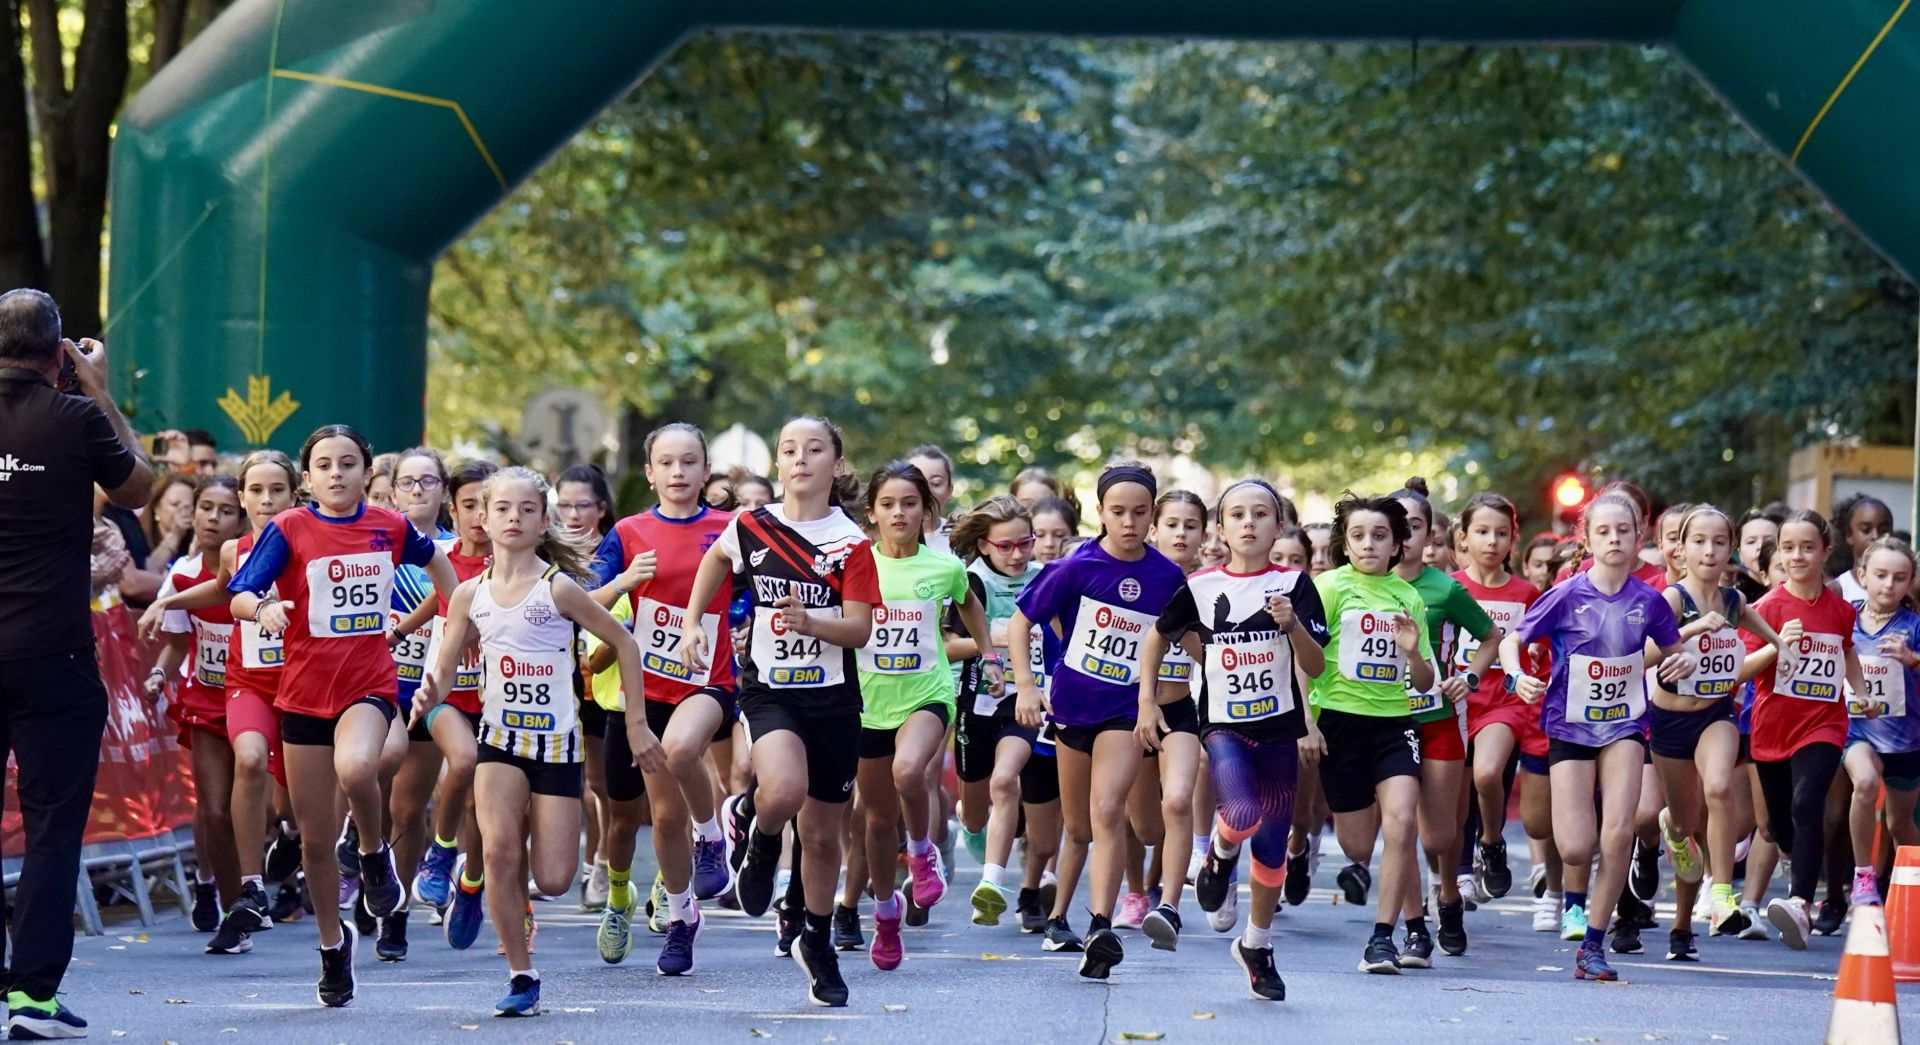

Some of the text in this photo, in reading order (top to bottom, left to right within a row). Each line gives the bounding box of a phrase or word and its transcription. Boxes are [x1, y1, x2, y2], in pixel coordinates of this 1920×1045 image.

[328, 559, 380, 583] Bilbao
[332, 583, 379, 608] 965
[354, 615, 380, 630] BM
[874, 604, 922, 625] Bilbao
[1095, 607, 1141, 634] Bilbao
[875, 627, 919, 648] 974
[1085, 629, 1138, 661] 1401
[1698, 634, 1736, 654] Bilbao
[1799, 636, 1839, 655] Bilbao
[389, 640, 425, 659] 33
[774, 639, 822, 660] 344
[1361, 637, 1398, 659] 491
[500, 655, 553, 679] Bilbao
[893, 657, 918, 668] BM
[1221, 648, 1274, 671] Bilbao
[1700, 654, 1735, 674] 960
[1799, 657, 1835, 677] 720
[397, 665, 421, 678] BM
[662, 661, 688, 678] BM
[793, 669, 820, 682] BM
[1100, 663, 1128, 679] BM
[1375, 665, 1396, 680] BM
[1588, 661, 1632, 680] Bilbao
[1226, 669, 1274, 695] 346
[1589, 681, 1627, 701] 392
[1713, 680, 1735, 693] BM
[1810, 683, 1833, 697] BM
[503, 682, 550, 705] 958
[1409, 696, 1430, 709] BM
[1250, 700, 1274, 716] BM
[1605, 705, 1626, 720] BM
[523, 714, 550, 728] BM
